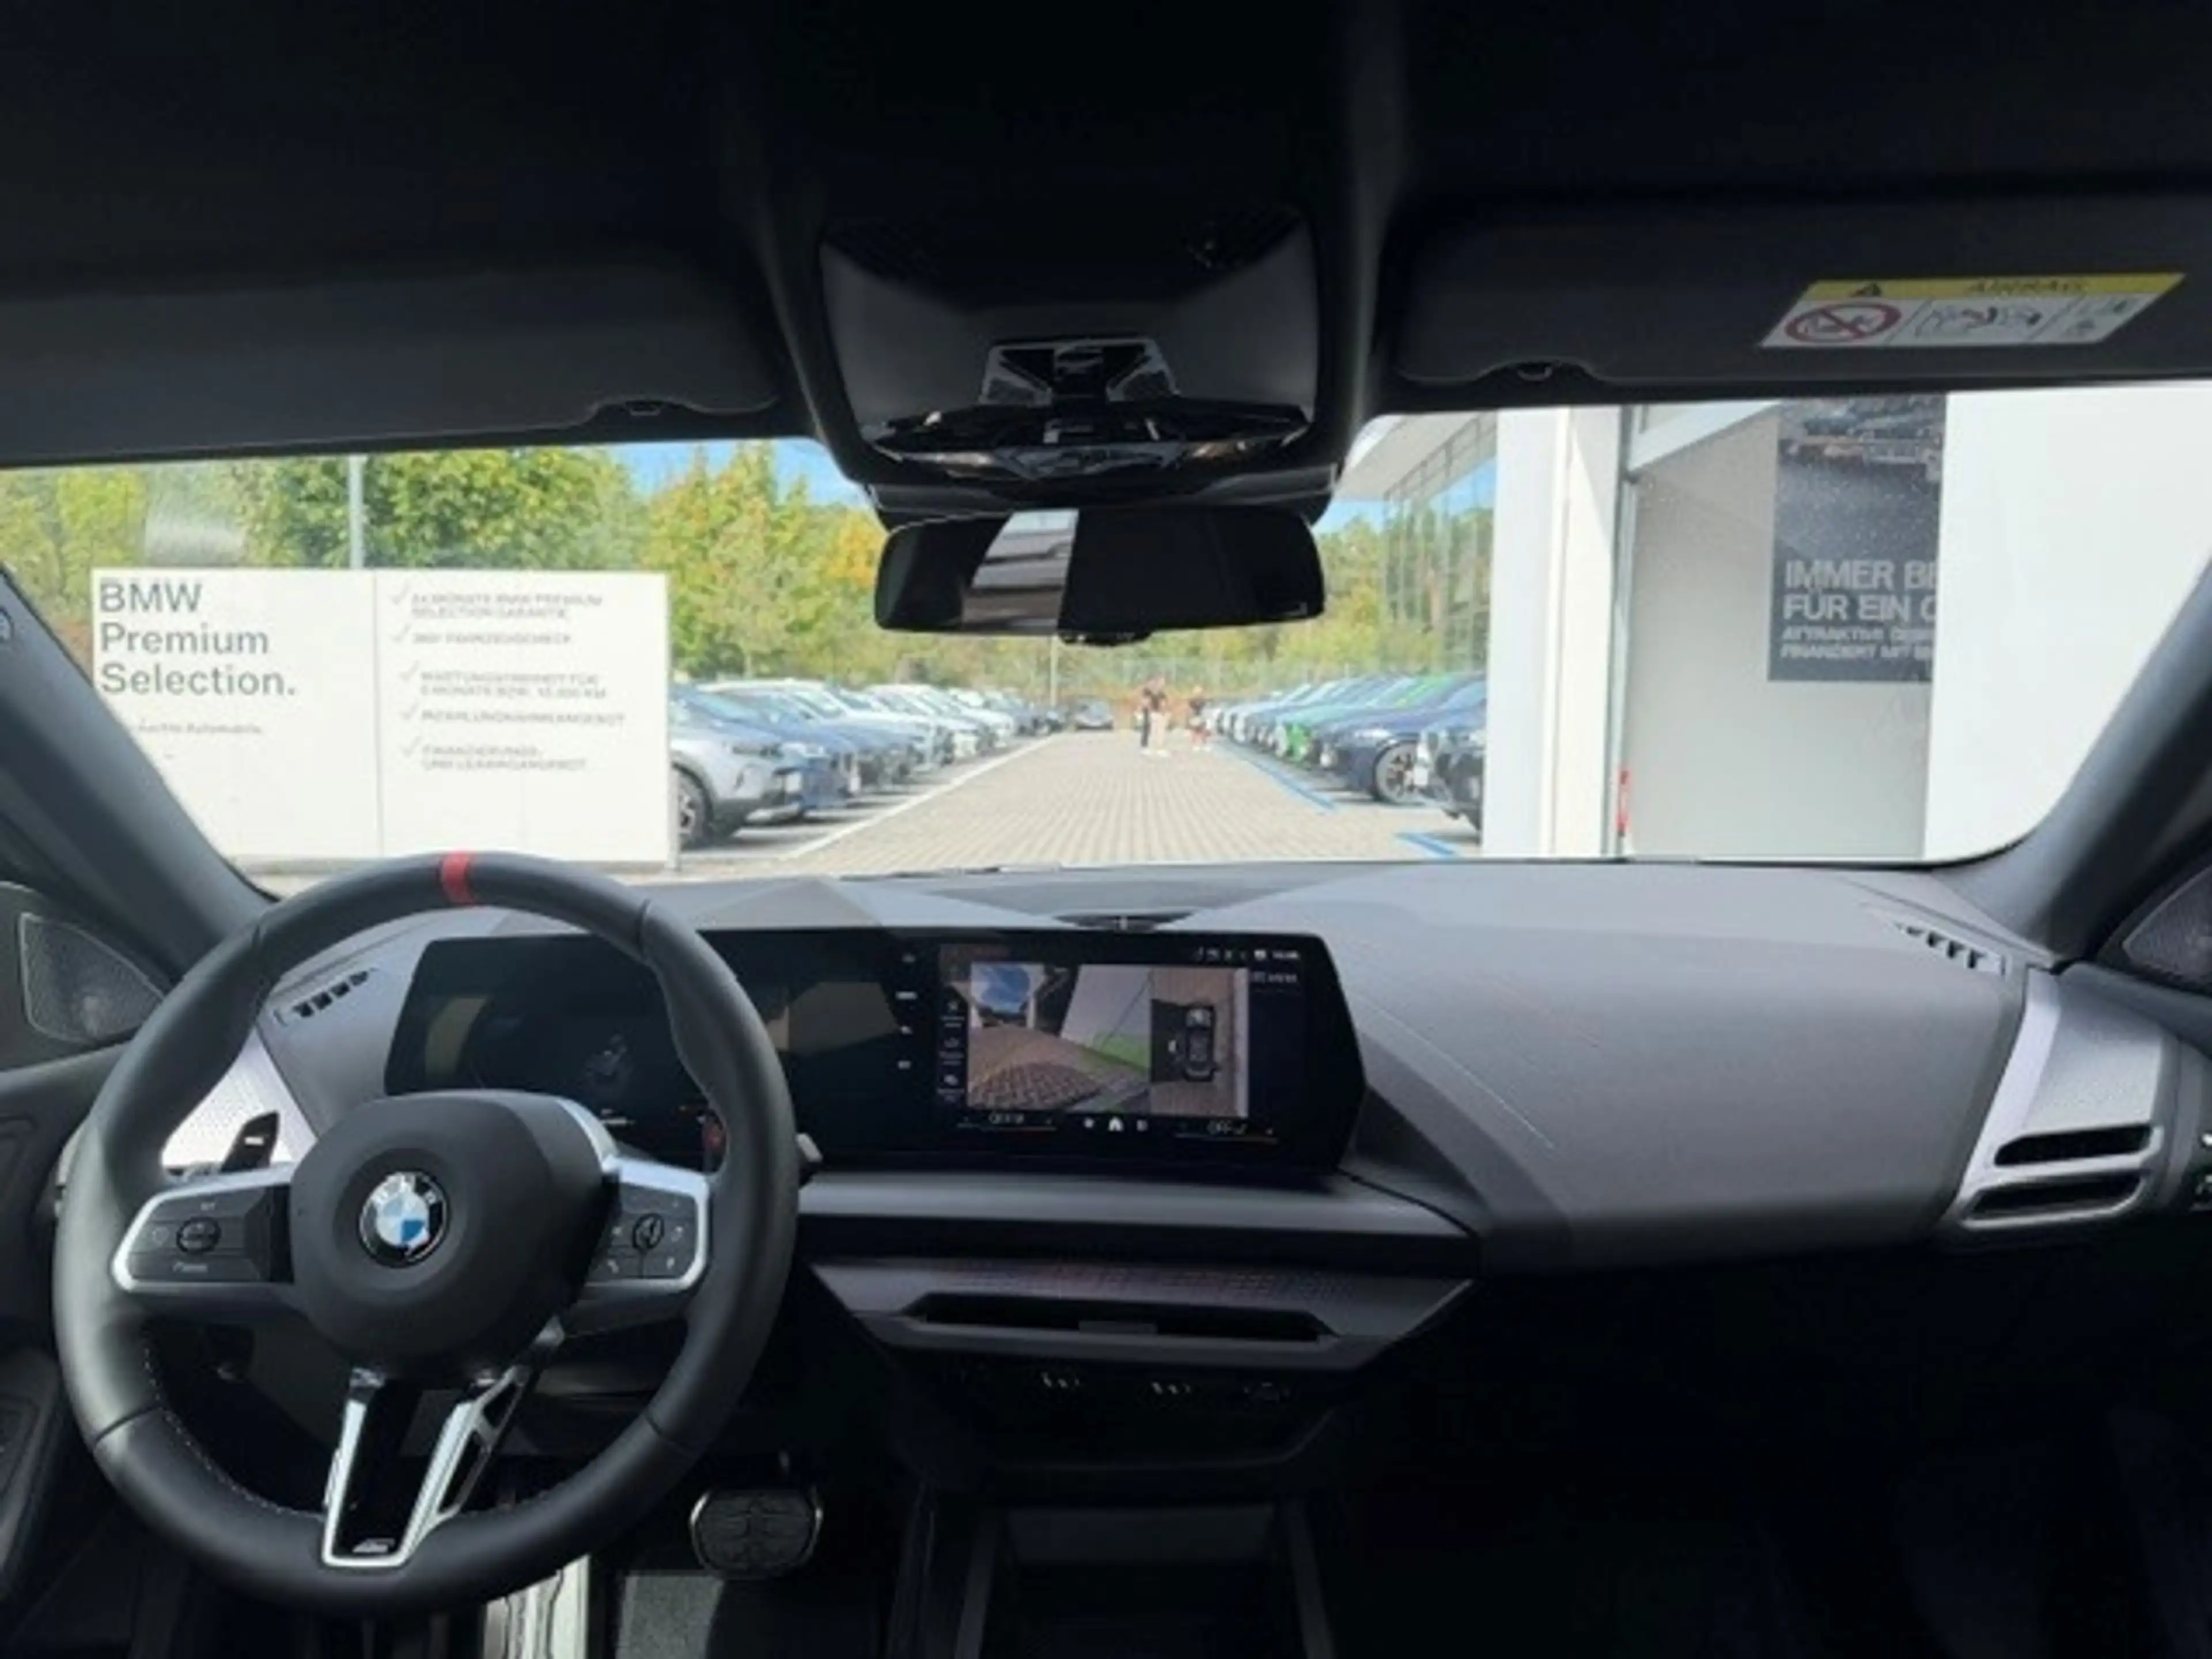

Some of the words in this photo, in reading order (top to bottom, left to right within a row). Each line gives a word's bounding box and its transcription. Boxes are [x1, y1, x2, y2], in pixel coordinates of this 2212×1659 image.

[1786, 559, 1895, 589] IMMER
[99, 582, 203, 613] BMW
[1783, 588, 1850, 620] FÜR
[1857, 594, 1910, 622] EIN
[100, 622, 269, 655] Premium
[101, 662, 296, 696] Selection.
